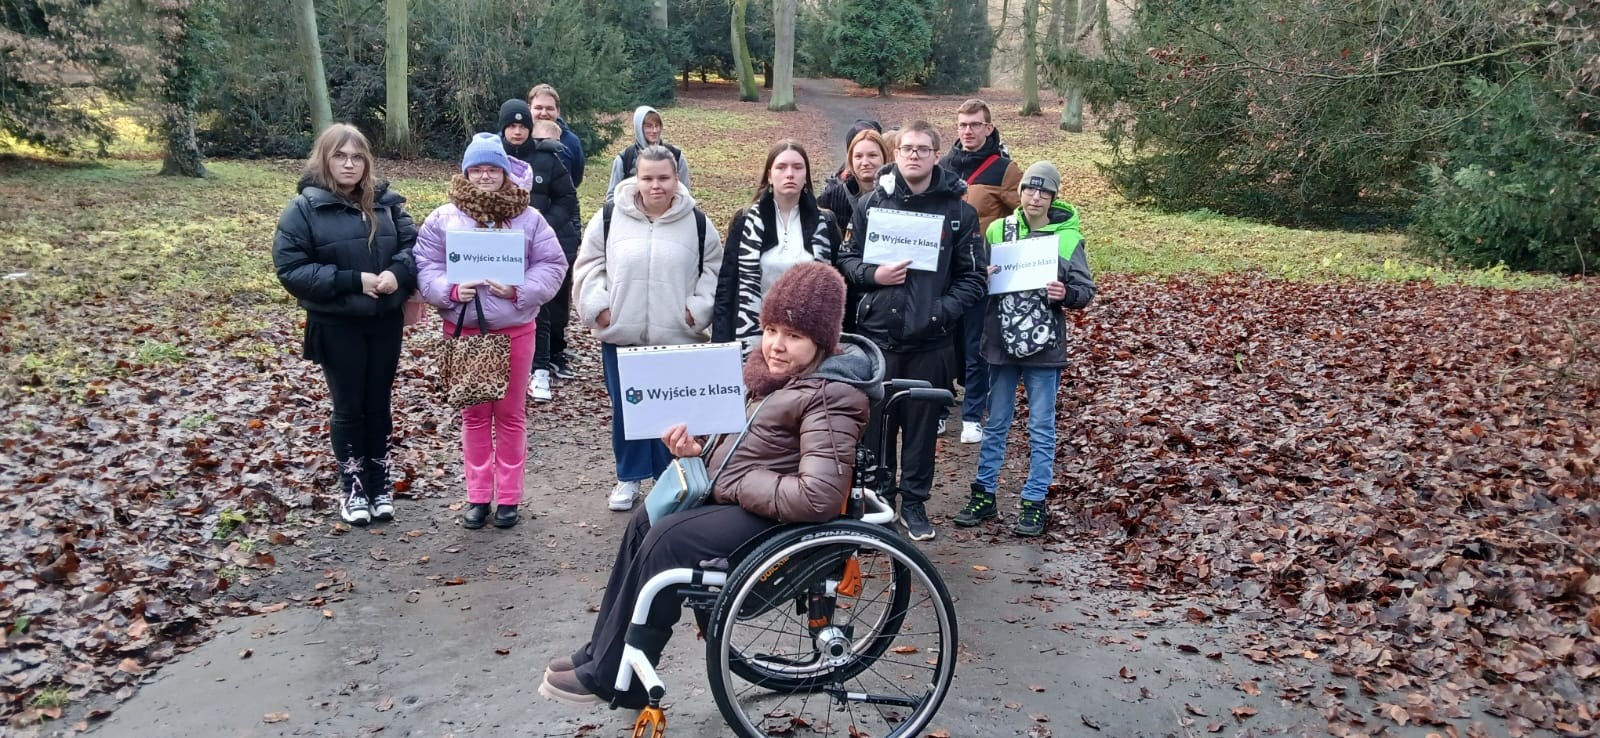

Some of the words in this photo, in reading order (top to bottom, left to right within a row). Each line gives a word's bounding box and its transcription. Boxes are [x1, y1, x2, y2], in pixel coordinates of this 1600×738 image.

[881, 234, 912, 245] Wyjście
[463, 254, 495, 263] Wyjście
[502, 255, 522, 264] klasą
[647, 386, 697, 401] Wyjście
[699, 387, 706, 396] z
[708, 383, 741, 396] klasą
